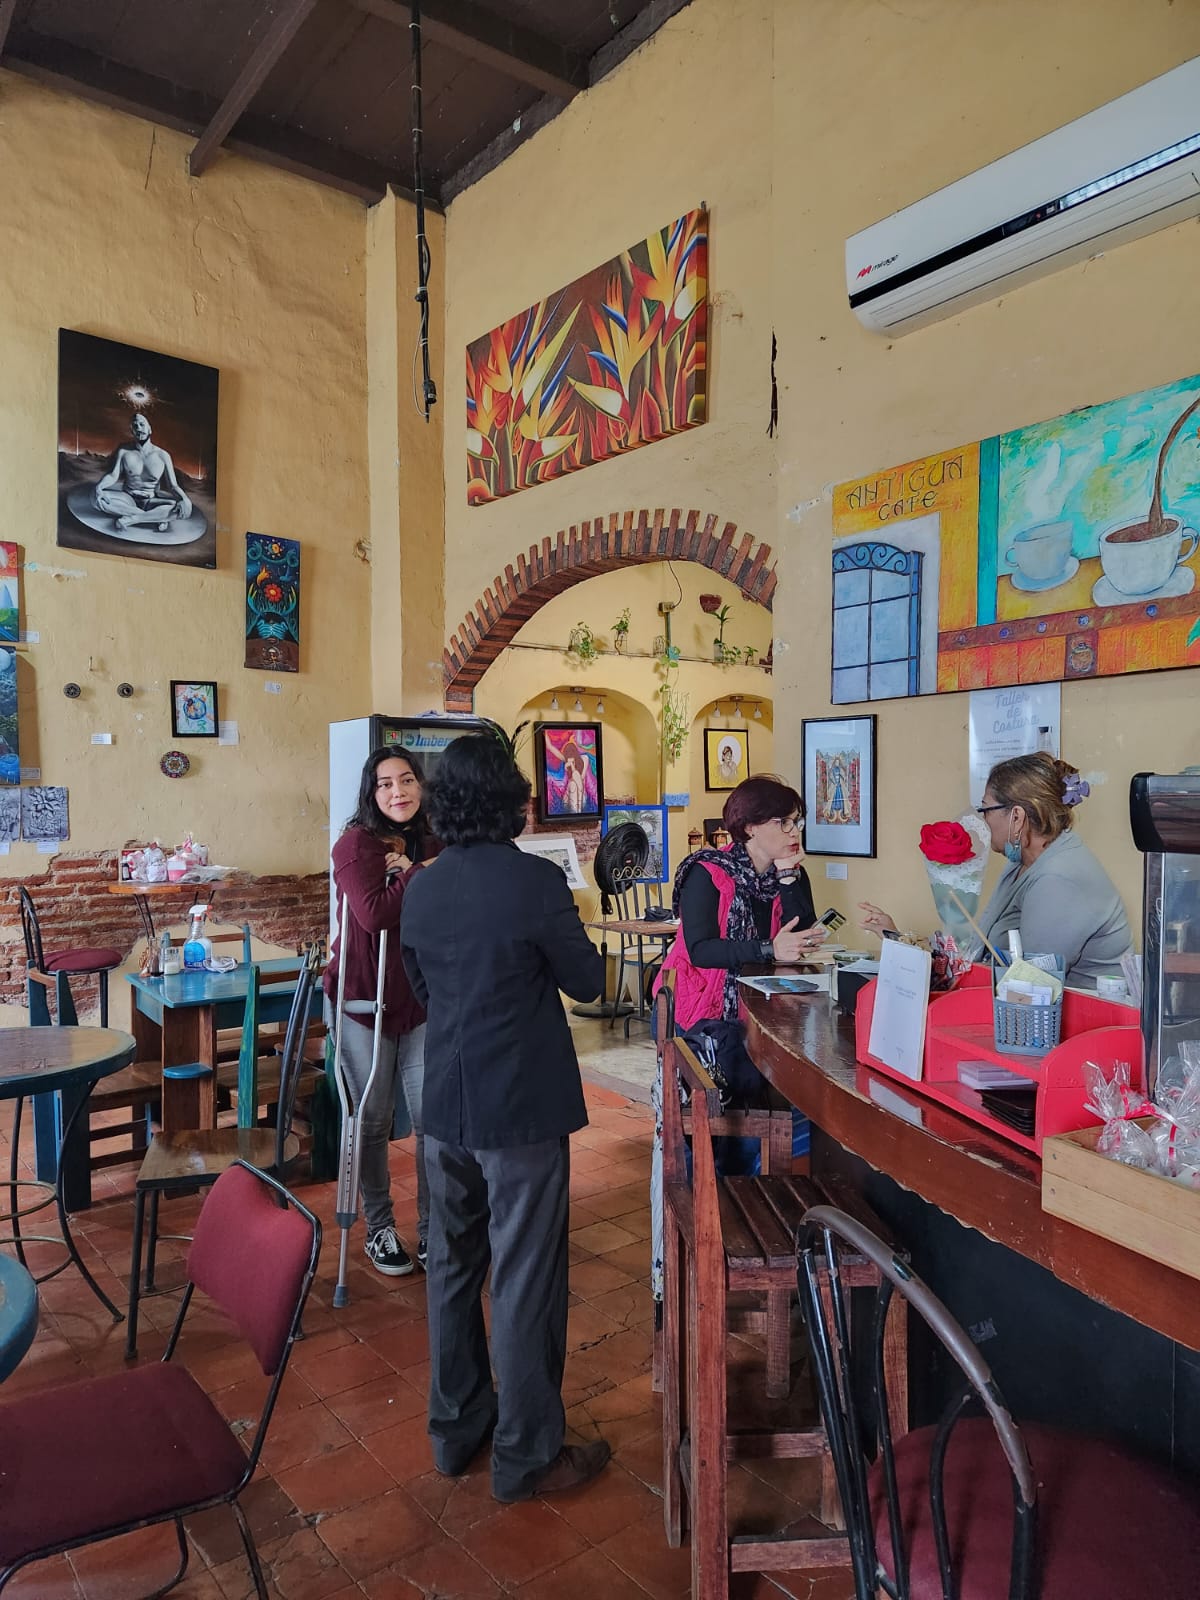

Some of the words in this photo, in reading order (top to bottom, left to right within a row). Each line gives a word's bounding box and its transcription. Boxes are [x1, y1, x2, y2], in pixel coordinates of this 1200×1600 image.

[846, 455, 963, 510] ANTIGUA
[1006, 705, 1022, 719] de
[992, 713, 1040, 734] Costua
[415, 734, 452, 747] Imber
